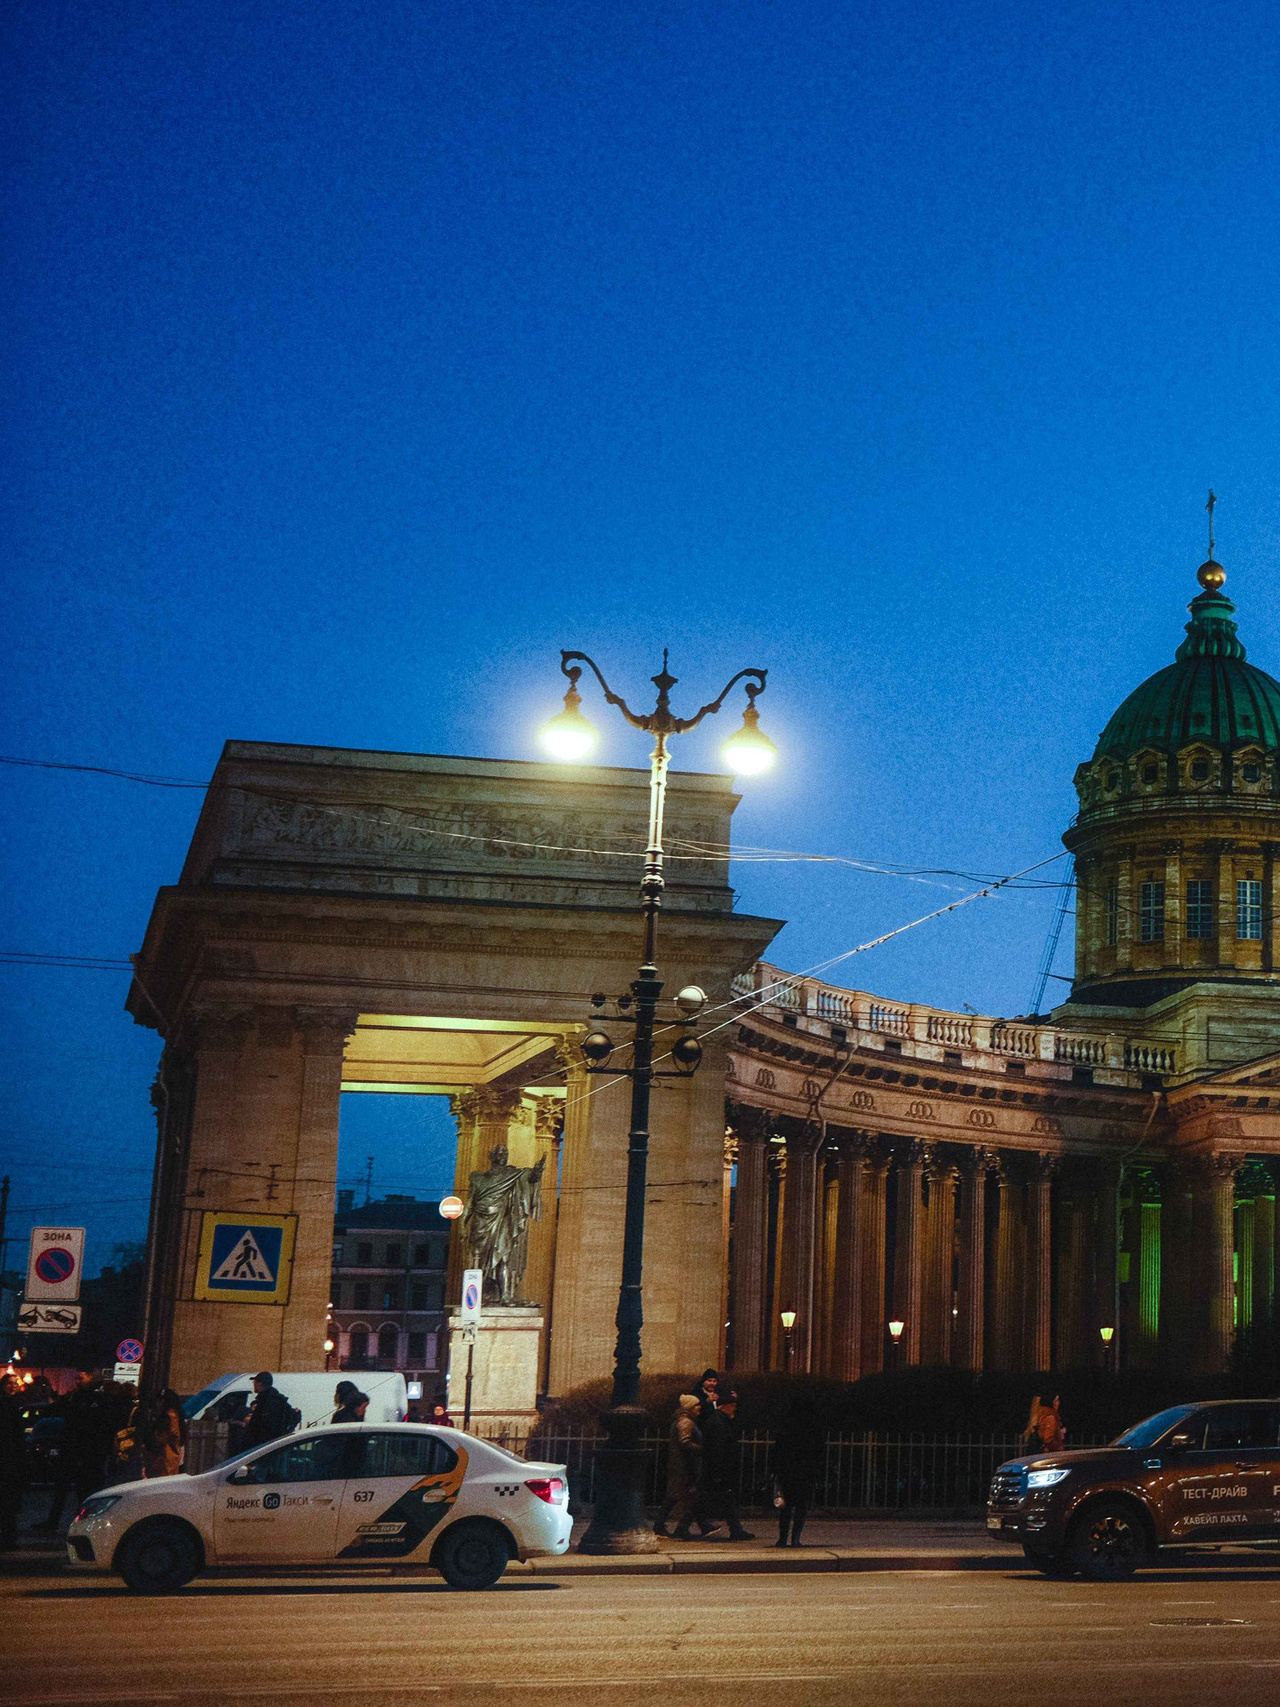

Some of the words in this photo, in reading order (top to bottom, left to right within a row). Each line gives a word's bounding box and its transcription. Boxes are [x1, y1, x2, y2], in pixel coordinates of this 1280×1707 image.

[42, 1232, 72, 1242] ЗОНА
[353, 1491, 375, 1503] 637
[1182, 1484, 1248, 1500] ТЕСТ-ДРАЙВ
[226, 1496, 260, 1509] Яндекс
[264, 1494, 280, 1508] Go
[283, 1494, 308, 1507] Такси
[1183, 1514, 1218, 1526] ХАВЕЙЛ
[1220, 1513, 1248, 1523] ЛАХТА
